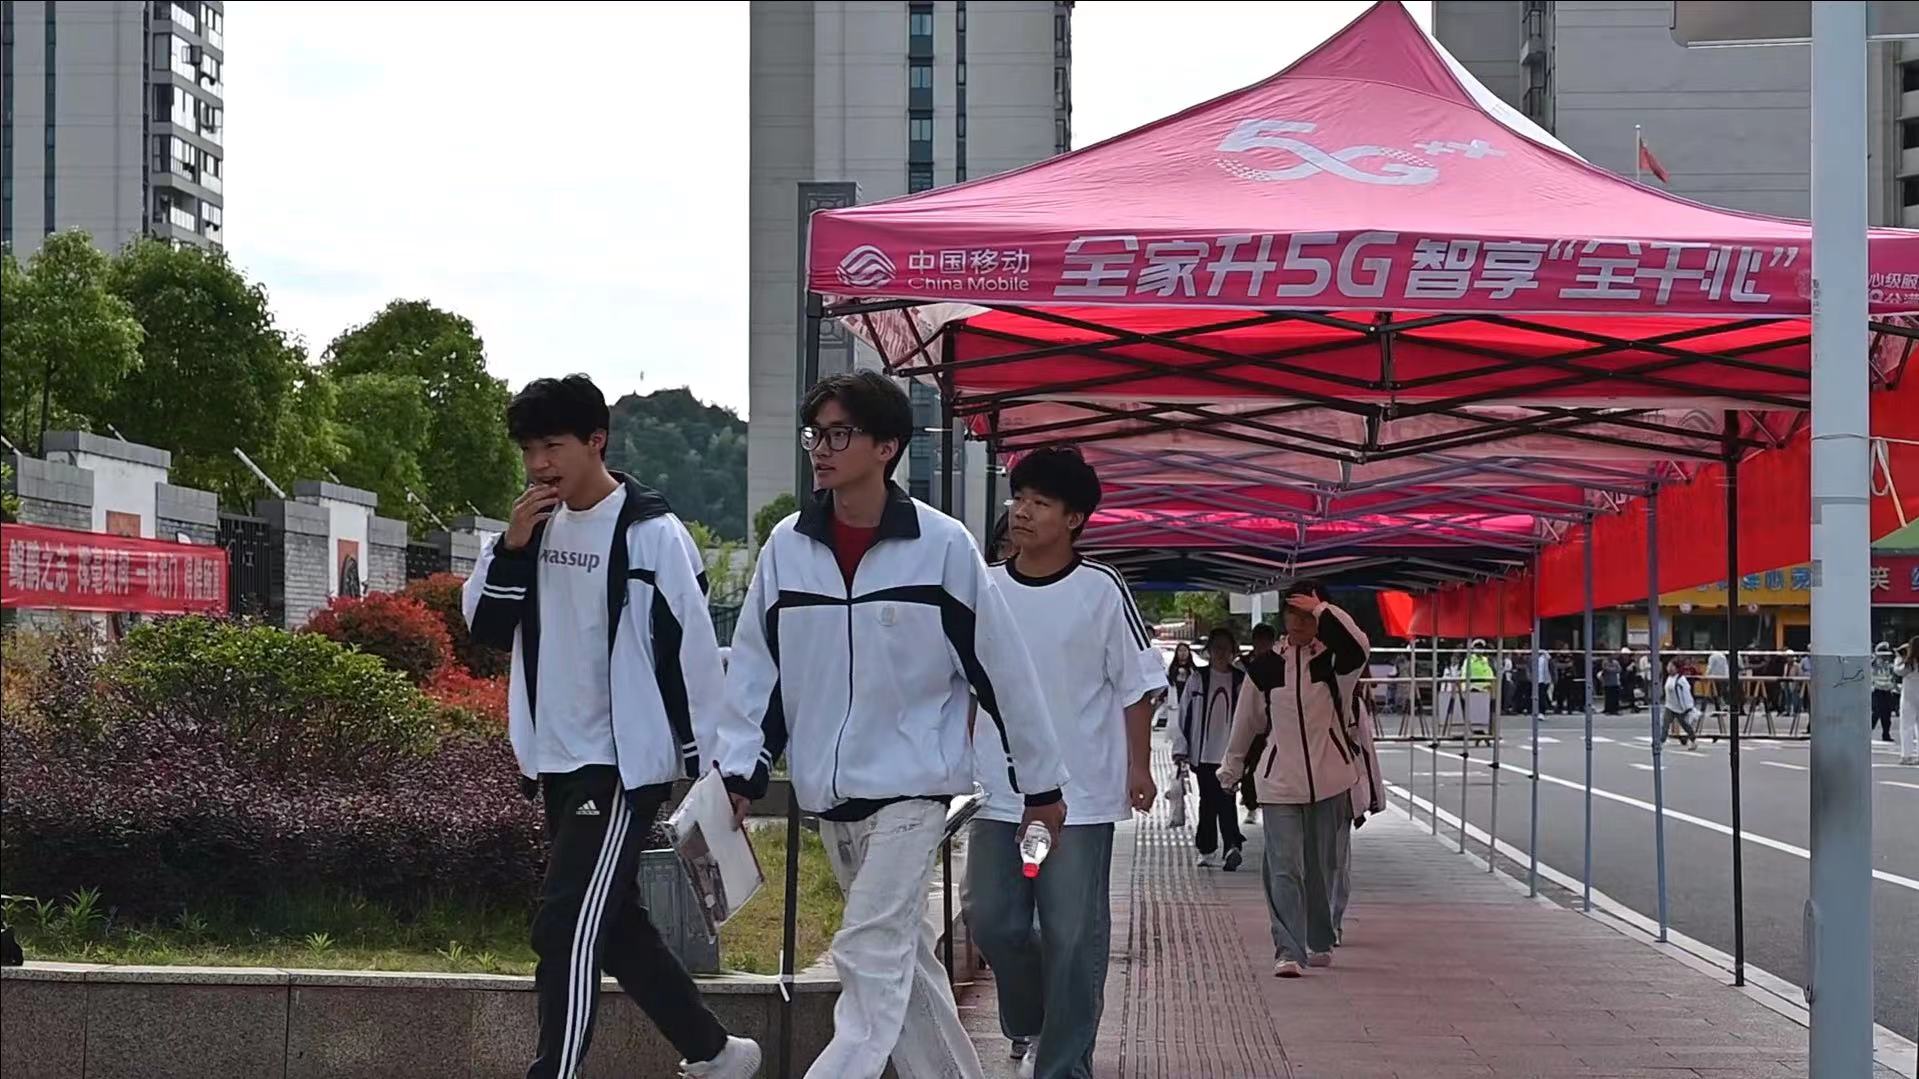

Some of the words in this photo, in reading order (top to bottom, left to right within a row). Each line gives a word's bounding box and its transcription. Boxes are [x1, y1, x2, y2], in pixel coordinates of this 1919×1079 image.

[908, 248, 1030, 275] 中国移动
[1052, 231, 1400, 299] 全家升5G
[907, 276, 963, 290] China
[967, 276, 1030, 291] Mobile
